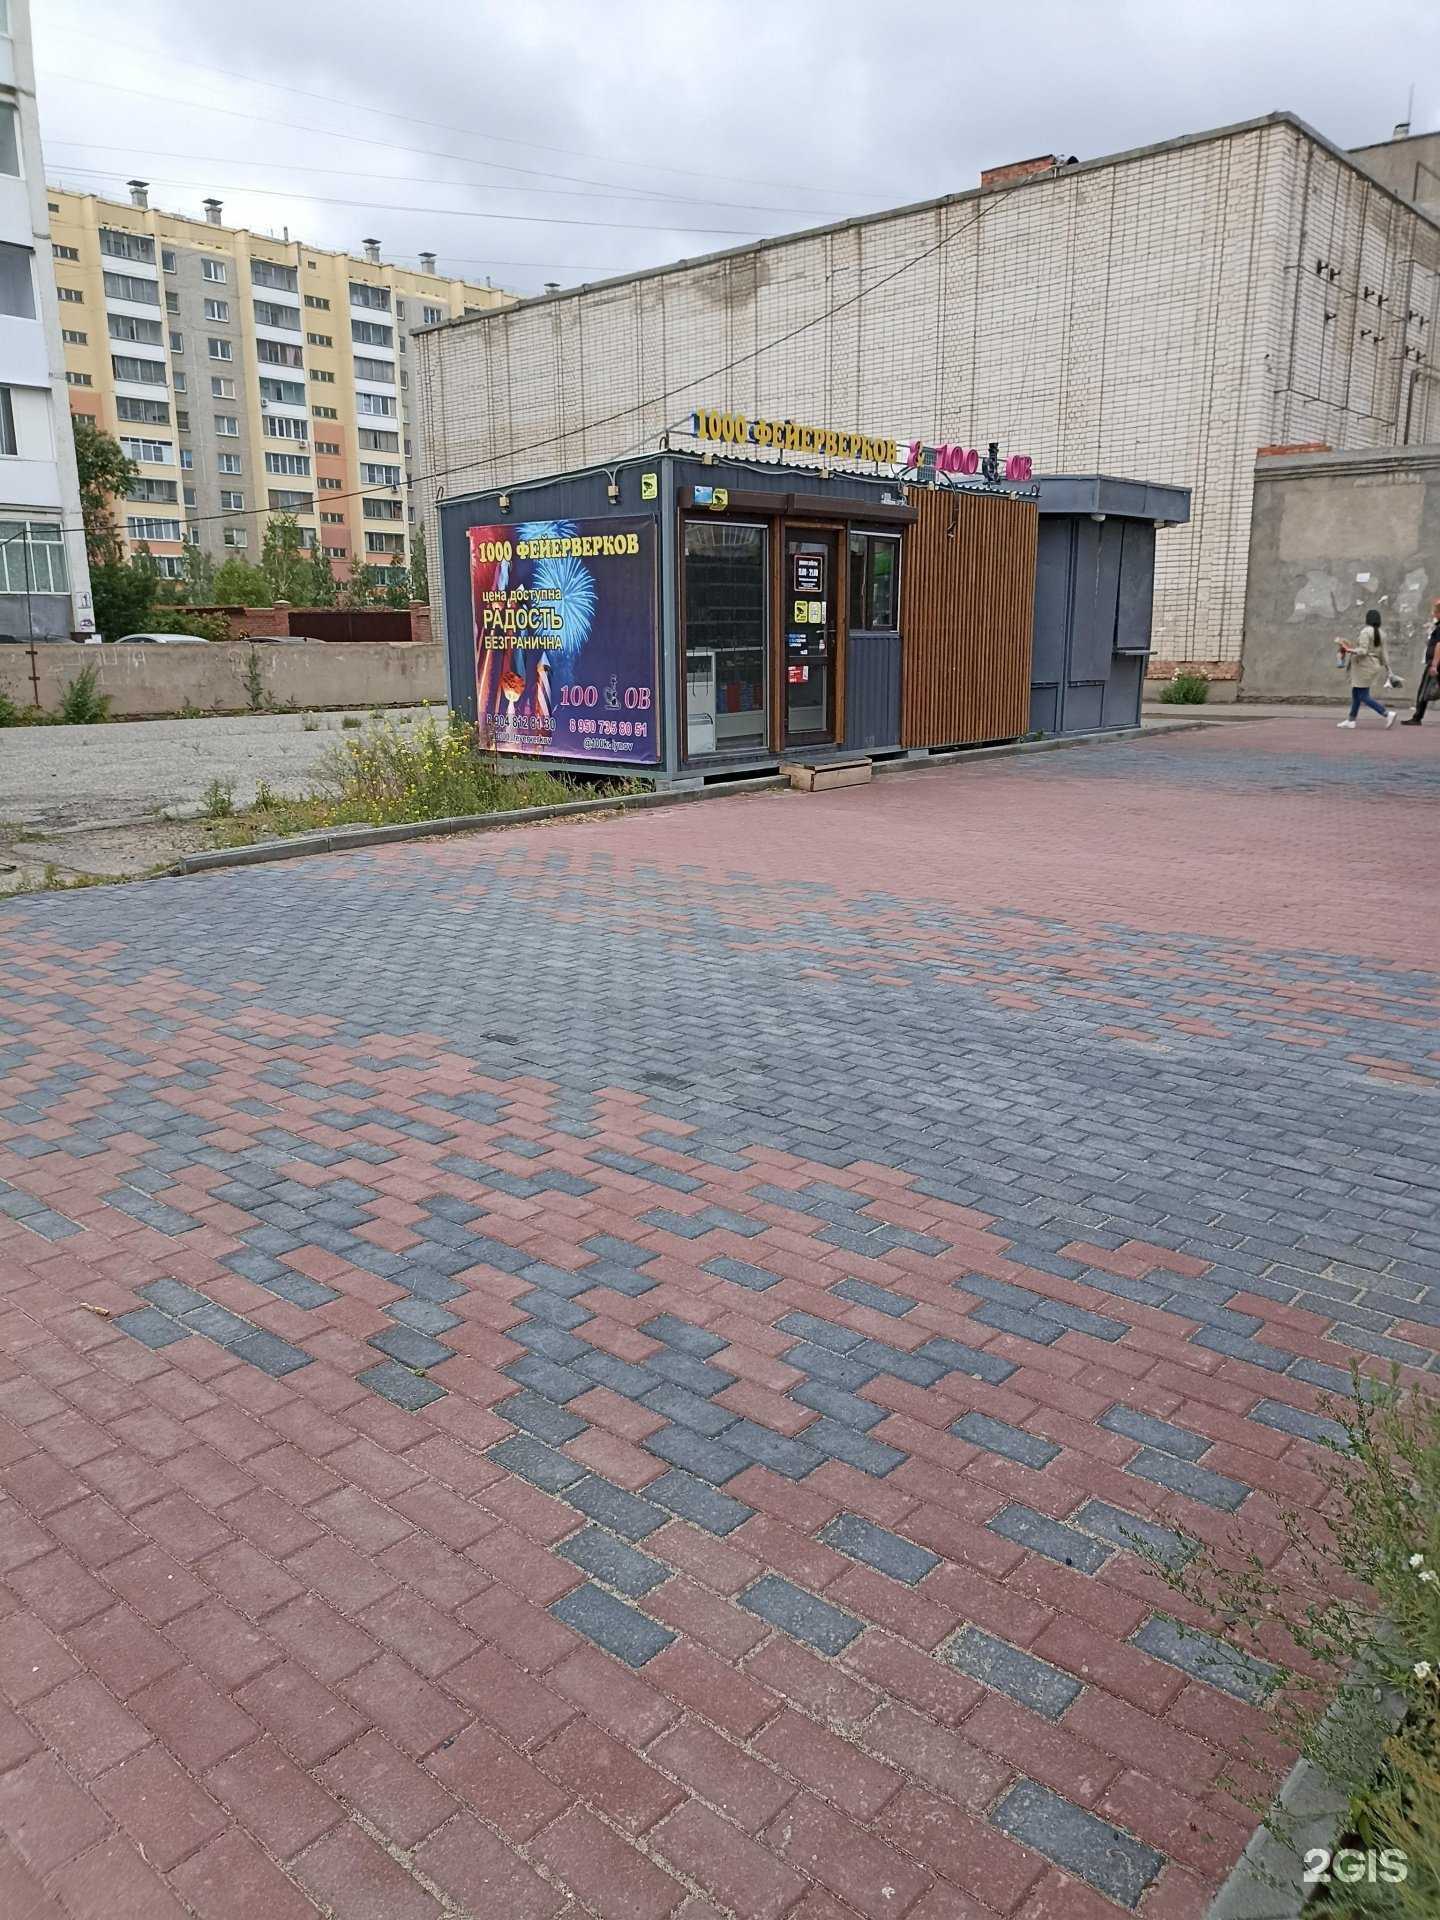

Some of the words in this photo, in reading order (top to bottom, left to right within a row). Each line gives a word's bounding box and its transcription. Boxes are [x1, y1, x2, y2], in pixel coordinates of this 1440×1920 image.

[695, 408, 748, 443] 1000
[936, 444, 979, 475] 100
[478, 541, 512, 563] 1000
[516, 533, 639, 560] ФЕЙЕРВЕРКОВ
[482, 590, 507, 602] цена
[509, 589, 562, 604] доступна
[483, 607, 563, 632] РАДОСТЬ
[484, 636, 563, 650] БЕЗГРАНИЧНА
[560, 685, 598, 707] 100
[624, 687, 651, 709] ОВ
